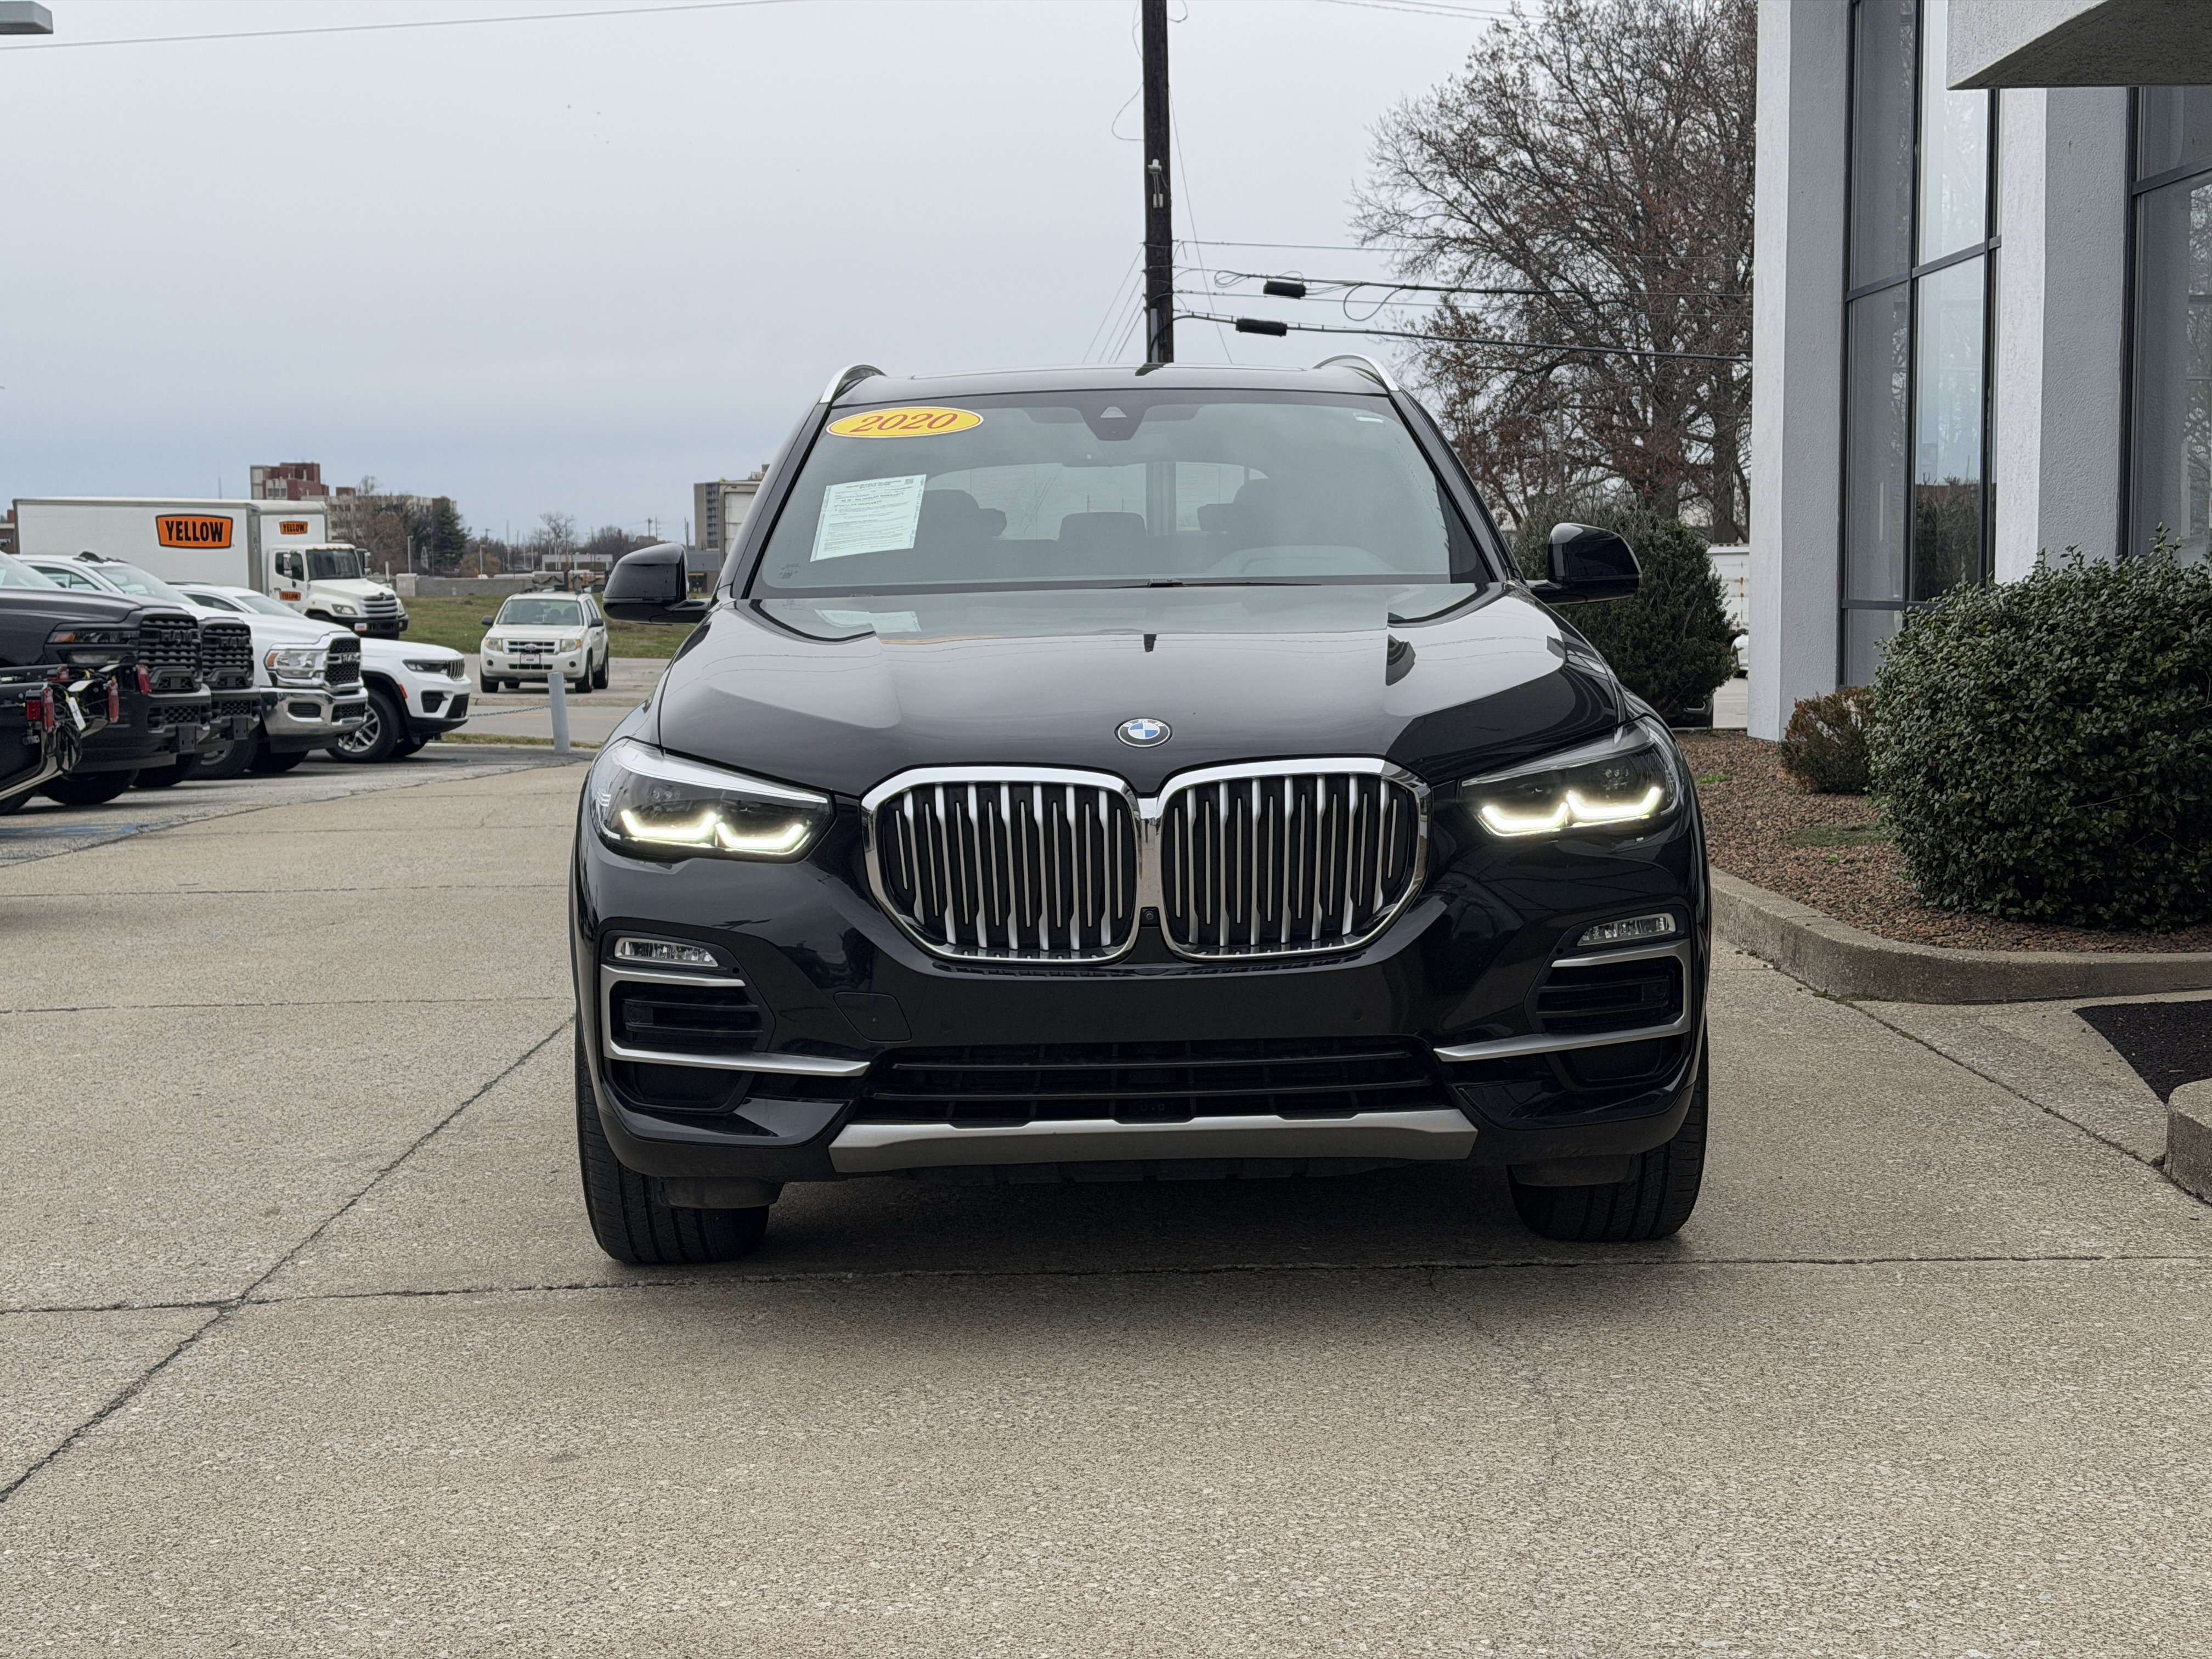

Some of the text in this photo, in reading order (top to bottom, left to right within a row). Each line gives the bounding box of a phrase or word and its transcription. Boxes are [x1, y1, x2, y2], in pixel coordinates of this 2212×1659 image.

[849, 413, 958, 433] 2020
[165, 521, 223, 542] YELLOW
[283, 523, 305, 532] YELLOW
